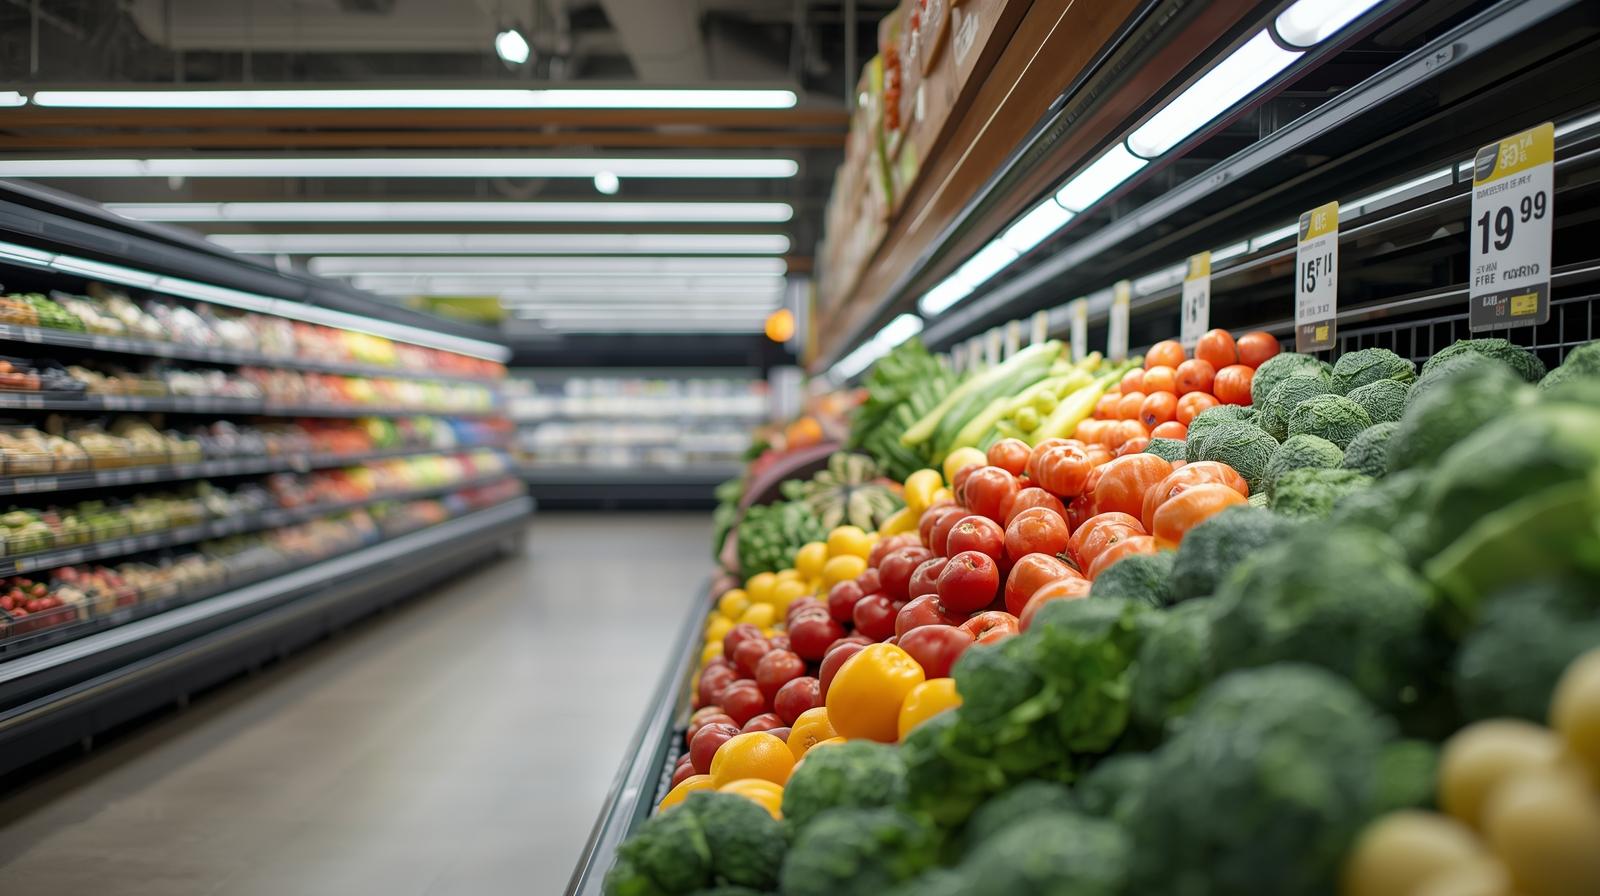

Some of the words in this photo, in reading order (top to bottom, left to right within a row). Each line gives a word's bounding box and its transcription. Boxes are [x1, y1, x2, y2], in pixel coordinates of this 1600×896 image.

[1477, 205, 1514, 255] 19
[1519, 190, 1547, 224] 99
[1301, 260, 1316, 293] 15
